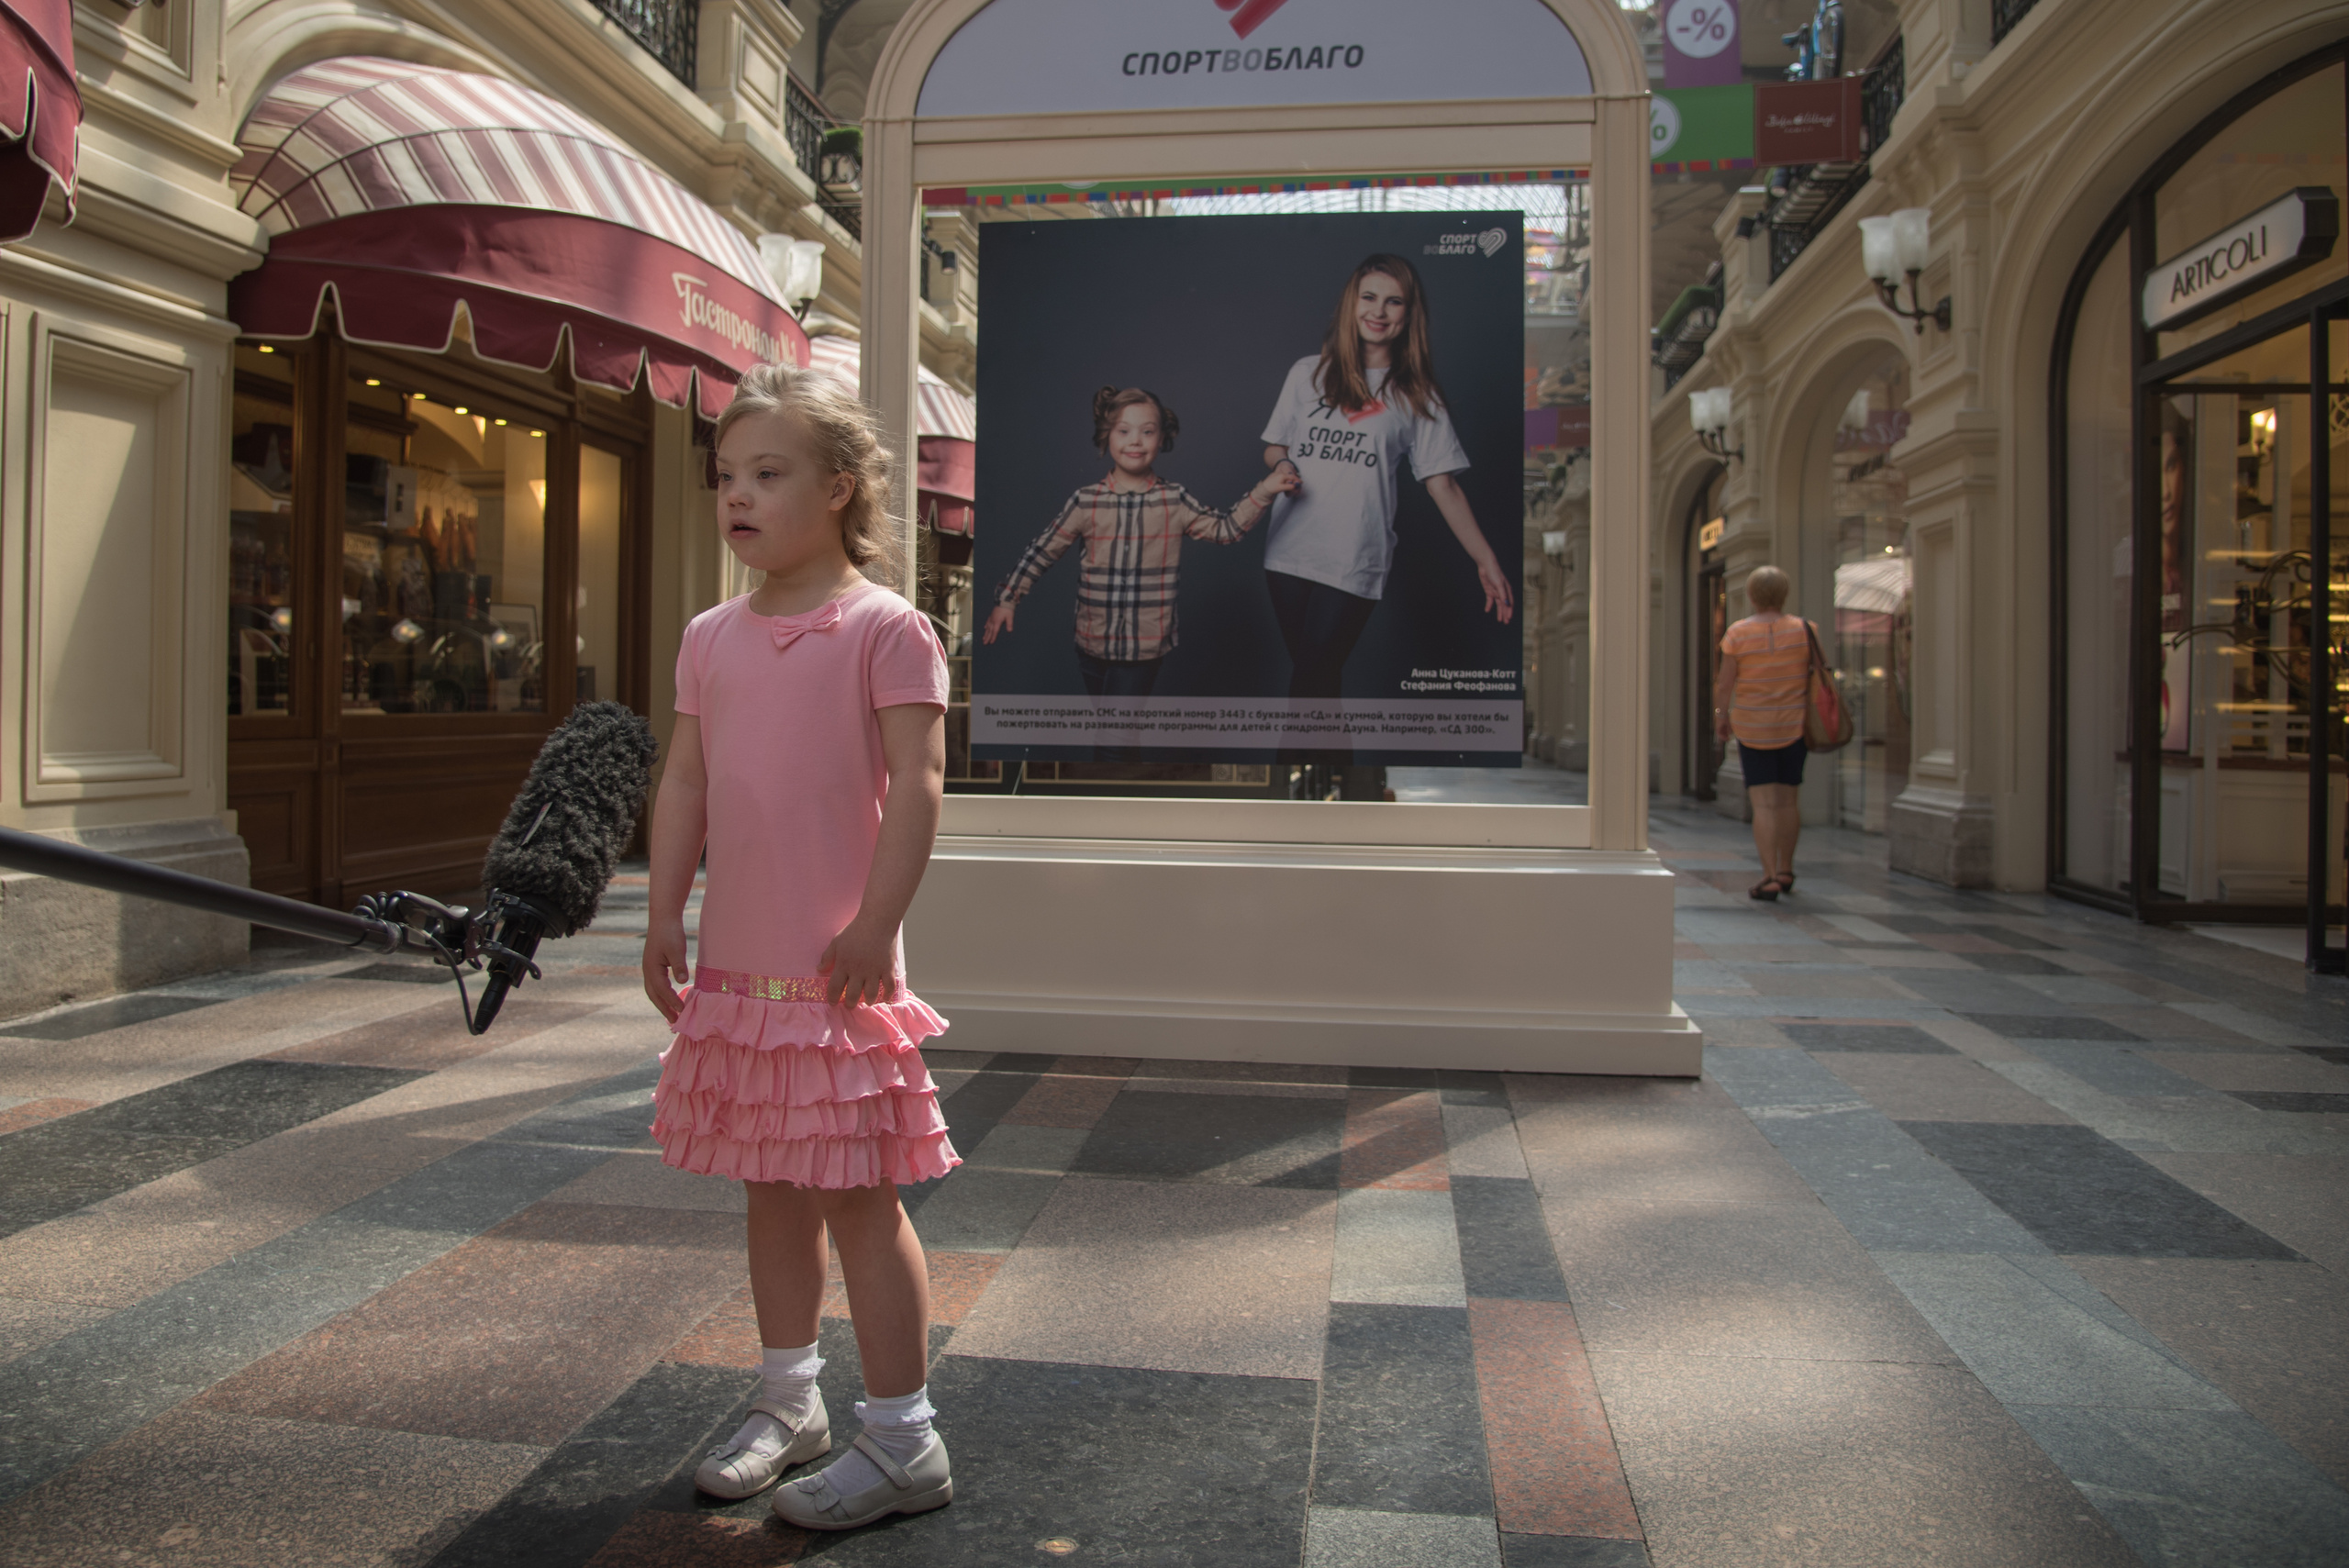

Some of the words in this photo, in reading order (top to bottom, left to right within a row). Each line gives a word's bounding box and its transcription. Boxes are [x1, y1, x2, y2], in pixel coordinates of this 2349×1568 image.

[1122, 45, 1364, 76] СПОРТВОБЛАГО
[1440, 234, 1477, 244] СПОРТ
[2170, 225, 2266, 304] ARTICOLI
[1308, 427, 1367, 447] СПОРТ
[1319, 445, 1377, 468] БЛАГО
[1411, 668, 1437, 679] Анна
[1439, 668, 1517, 680] Цуканова-Котт
[1400, 680, 1452, 693] Стефания
[1453, 681, 1517, 693] Феофанова
[984, 706, 999, 716] Вы
[1001, 708, 1041, 717] можете
[1042, 708, 1095, 717] отправить
[1097, 707, 1117, 717] СМС
[1134, 708, 1181, 719] короткий
[1184, 710, 1217, 719] номер
[1219, 709, 1246, 718] 3443
[1256, 709, 1300, 721] буквами
[1343, 711, 1386, 722] суммой,
[1388, 713, 1434, 722] которую
[1437, 713, 1452, 721] вы
[1454, 714, 1491, 722] хотели
[1494, 712, 1509, 722] бы
[996, 720, 1068, 729] пожертвовать
[1070, 721, 1082, 729] на
[1085, 722, 1155, 731] развивающие
[1158, 723, 1217, 732] программы
[1219, 723, 1239, 732] для
[1241, 722, 1272, 732] детей
[1281, 724, 1341, 733] синдромом
[1342, 724, 1378, 734] Дауна.
